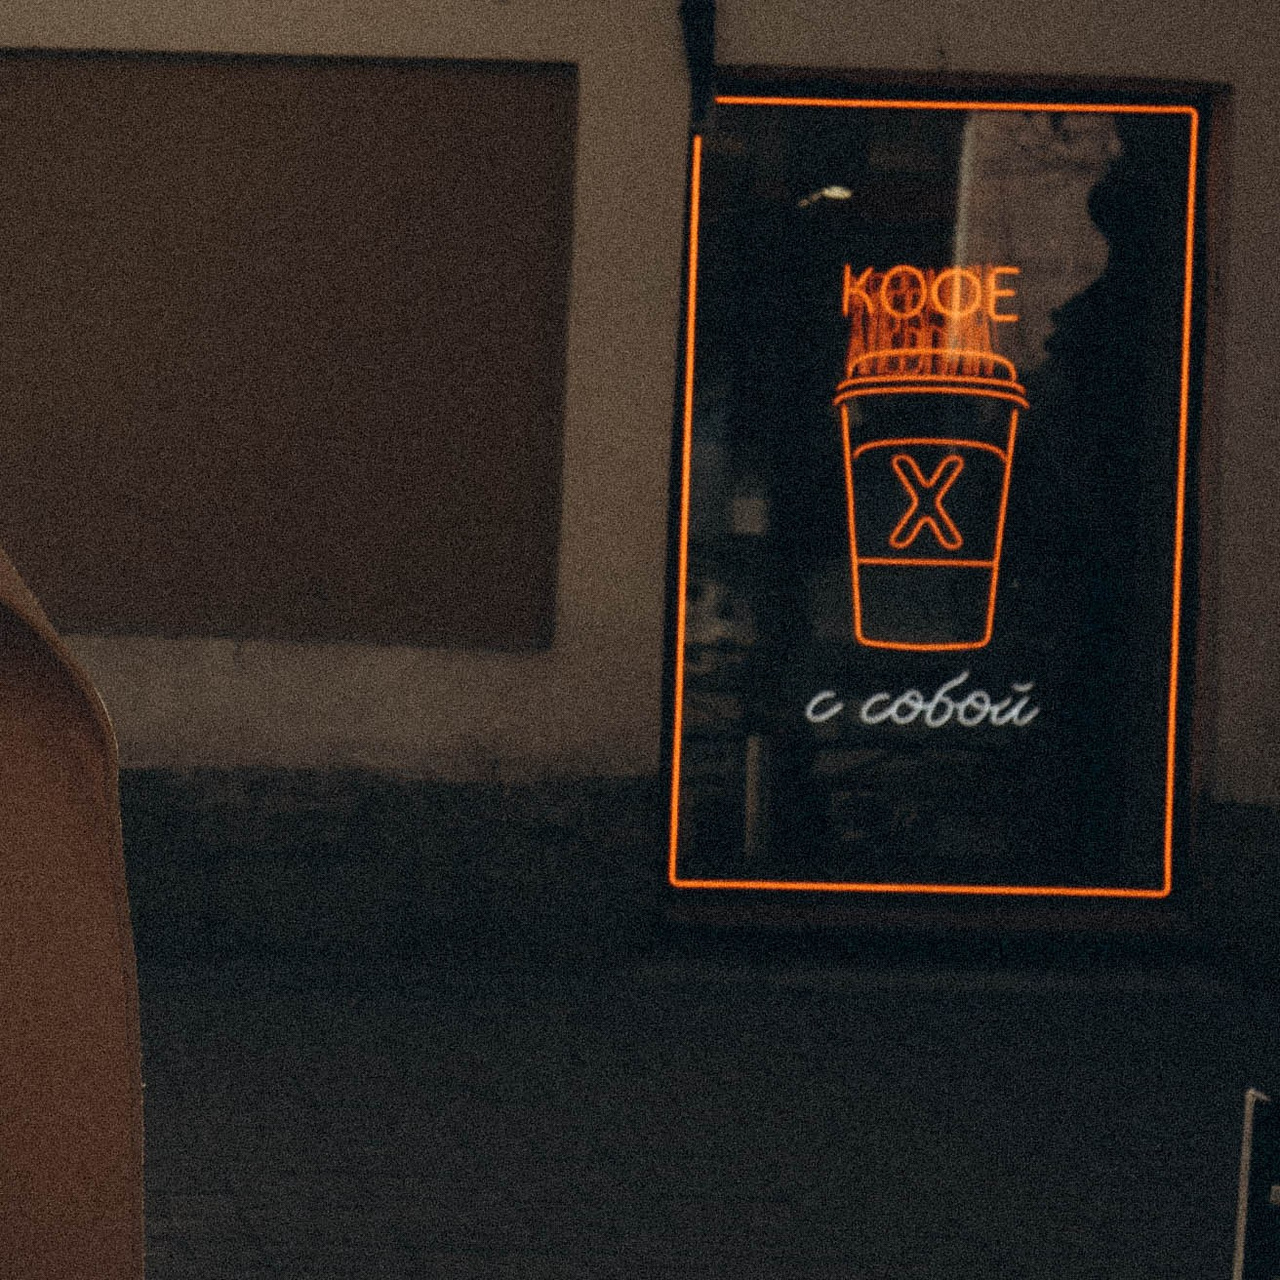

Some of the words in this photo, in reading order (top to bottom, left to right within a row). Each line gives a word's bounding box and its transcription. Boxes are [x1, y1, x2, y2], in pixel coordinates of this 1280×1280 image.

[841, 262, 1021, 322] КОФЕ
[805, 688, 844, 723] с
[859, 670, 1040, 729] собой
